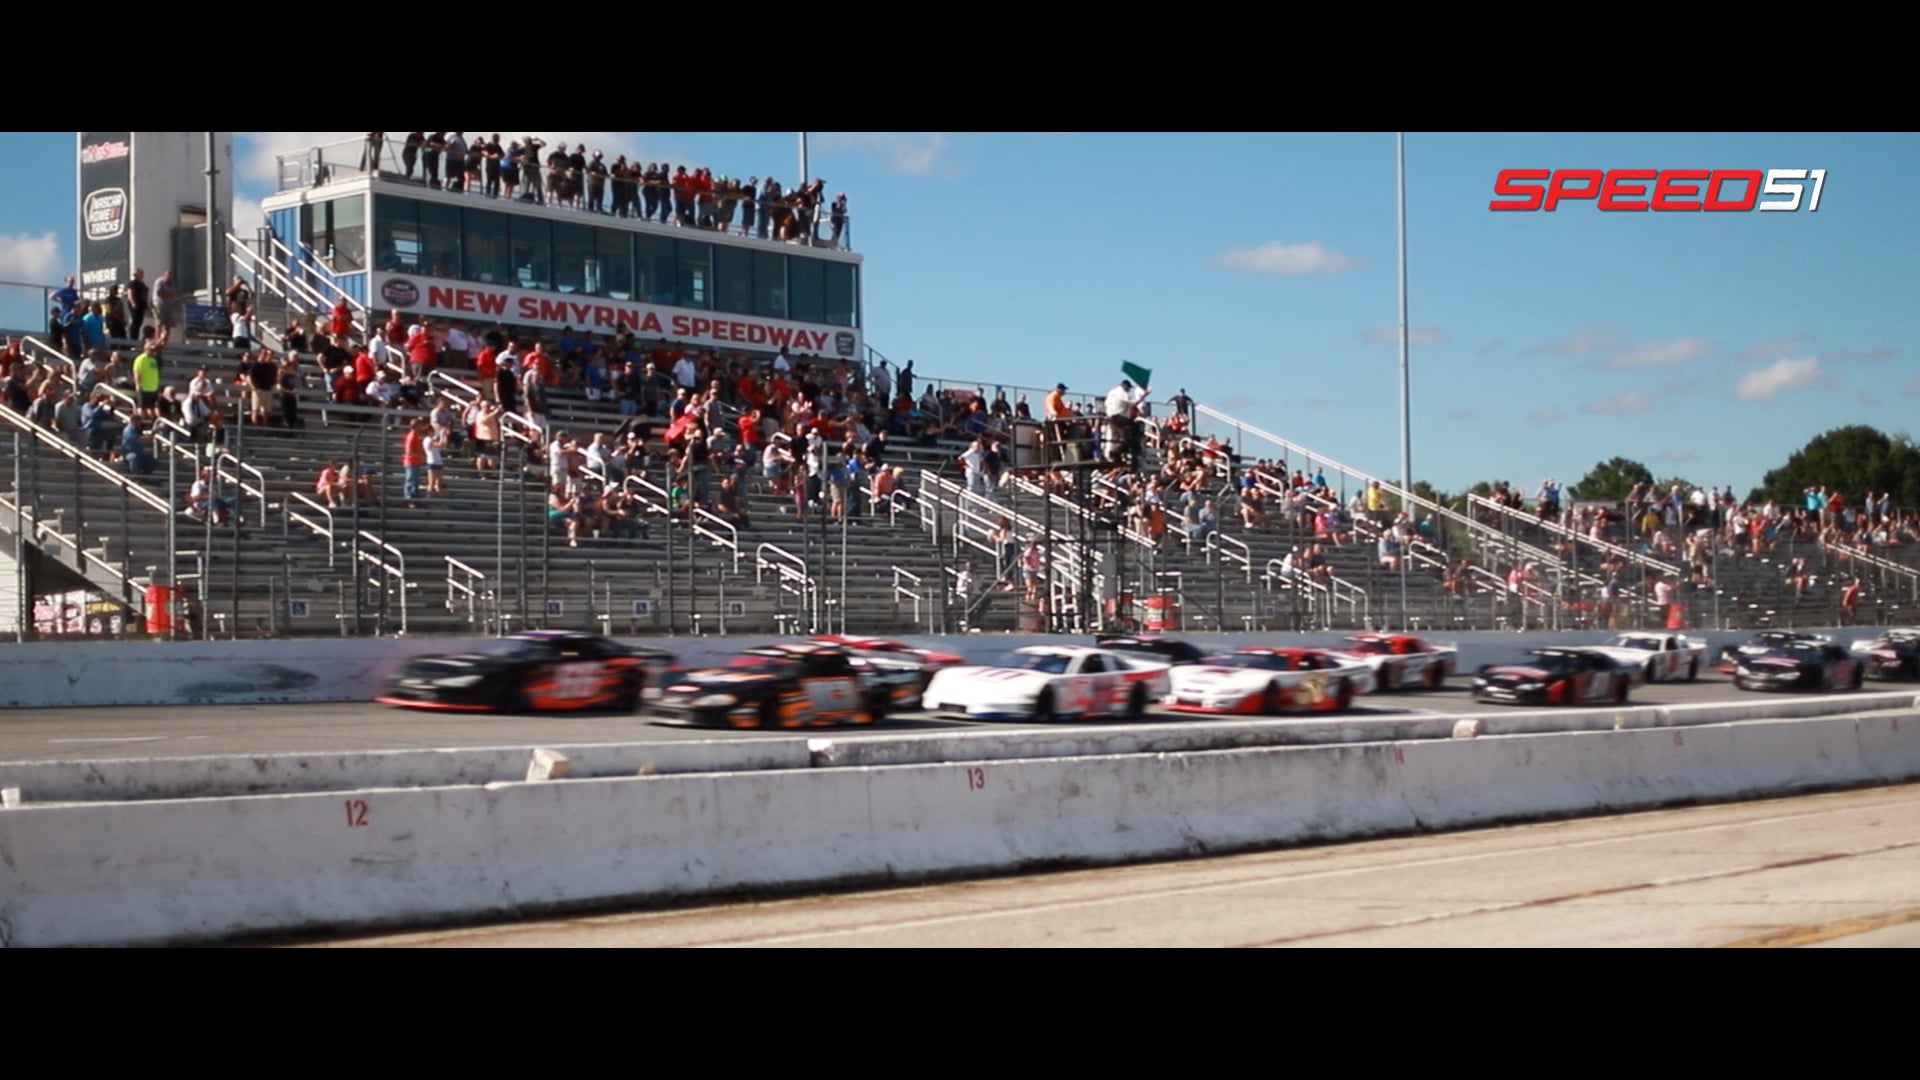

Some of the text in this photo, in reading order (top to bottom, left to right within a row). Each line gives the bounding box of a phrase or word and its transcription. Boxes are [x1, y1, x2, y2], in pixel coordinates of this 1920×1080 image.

[82, 267, 117, 285] WHERE
[428, 285, 508, 316] NEW
[518, 296, 663, 334] SMYRNA
[671, 314, 829, 351] SPEEDWAY
[967, 767, 985, 791] 13
[344, 800, 368, 827] 12
